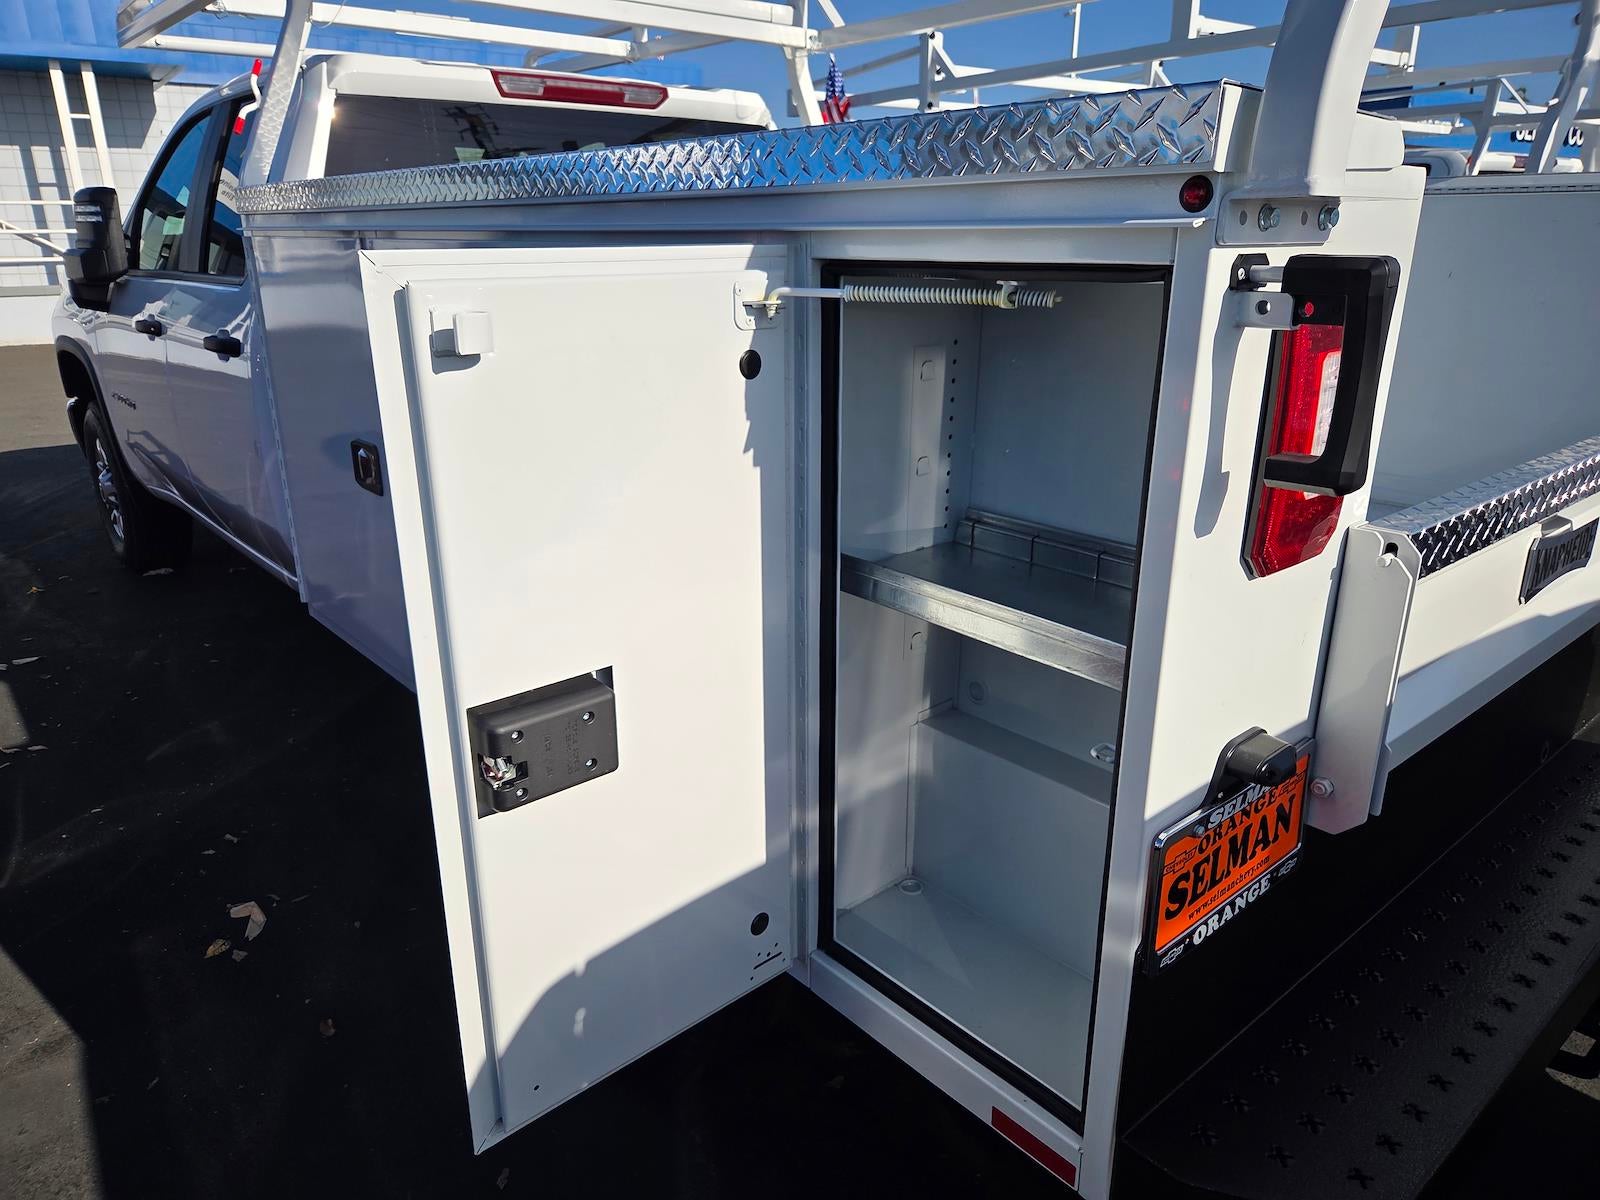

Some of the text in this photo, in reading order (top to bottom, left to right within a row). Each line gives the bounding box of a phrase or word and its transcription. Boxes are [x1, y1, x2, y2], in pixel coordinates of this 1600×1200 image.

[1197, 786, 1279, 855] ORANGE
[1165, 793, 1296, 921] SELMAN
[1188, 855, 1270, 920] www.selmanchevy.com
[1193, 873, 1271, 945] ORANGE
